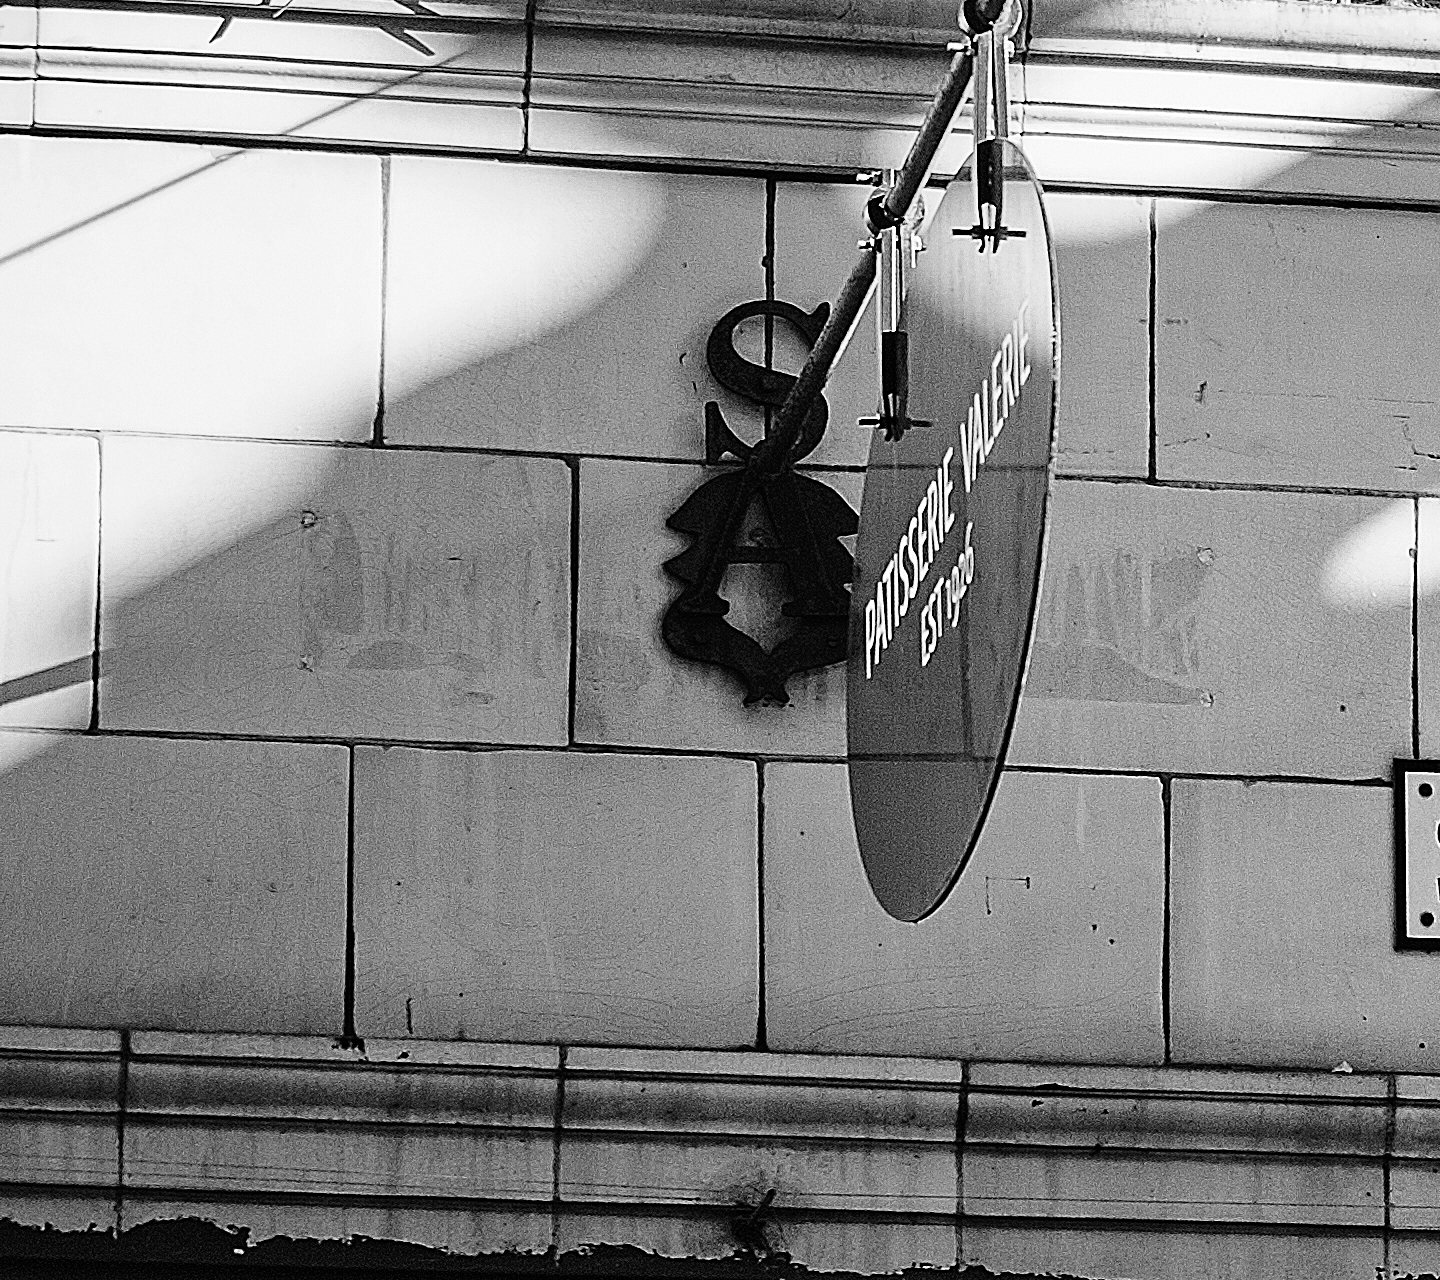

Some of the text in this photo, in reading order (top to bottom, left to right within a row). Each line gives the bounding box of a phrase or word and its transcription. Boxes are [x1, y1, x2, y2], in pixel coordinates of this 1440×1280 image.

[864, 300, 1031, 680] PATISSERIE VALERIE
[921, 577, 945, 667] EST
